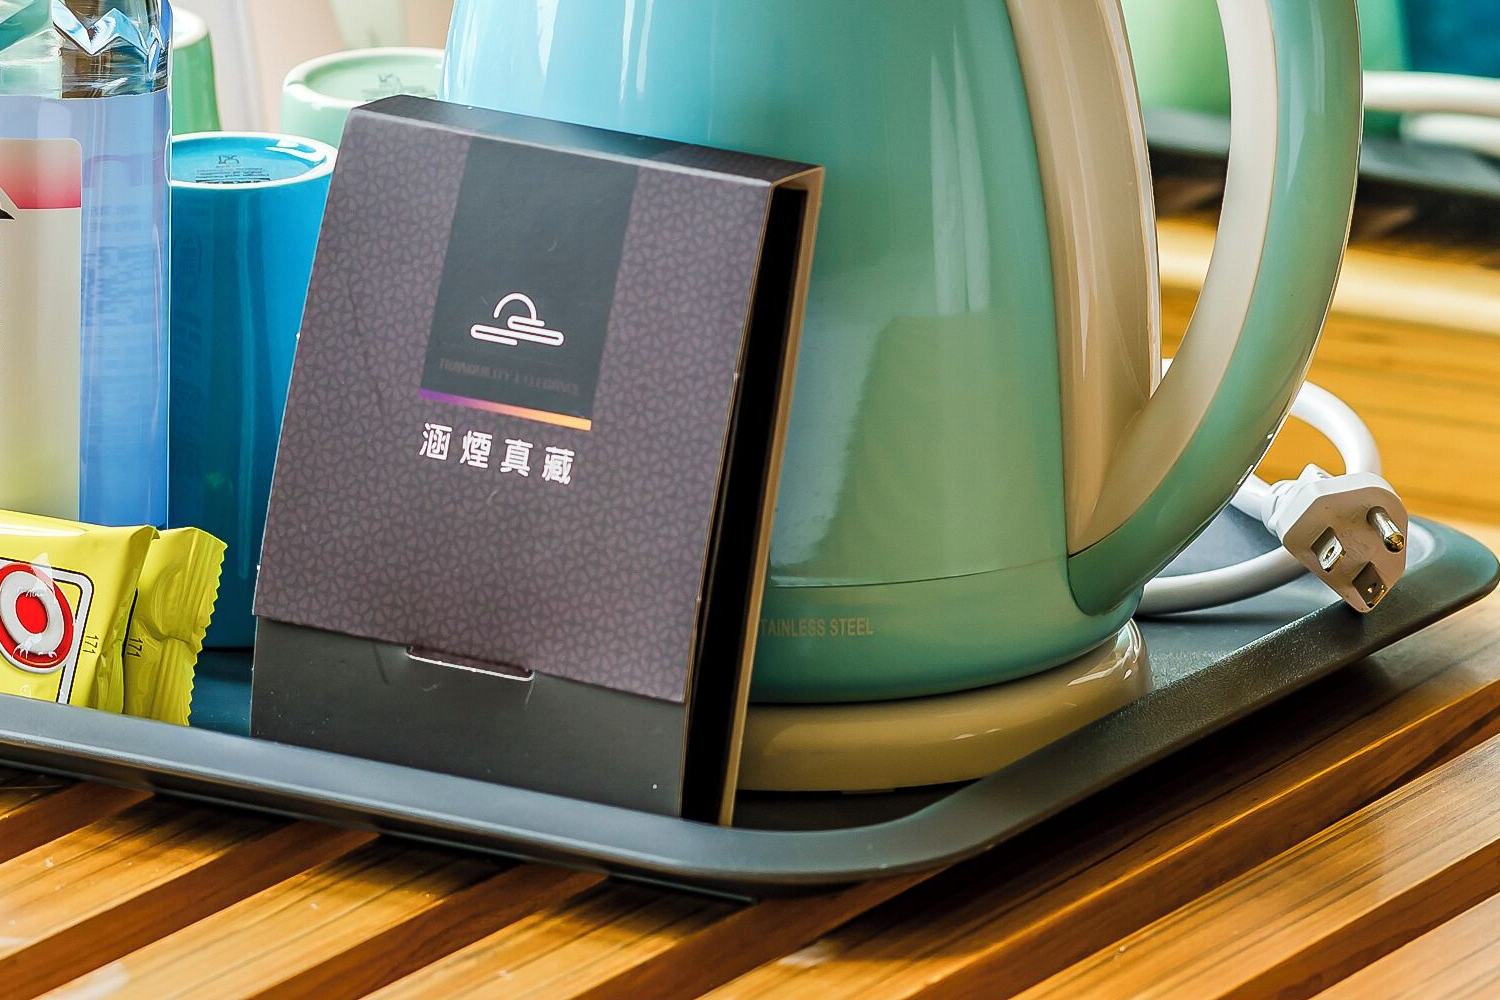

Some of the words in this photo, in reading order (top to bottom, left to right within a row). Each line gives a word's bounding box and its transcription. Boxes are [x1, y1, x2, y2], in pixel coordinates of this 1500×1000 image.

[419, 422, 575, 485] 涵煙真藏
[760, 618, 826, 638] TAINLESS
[829, 615, 874, 637] STEEL
[82, 635, 99, 654] 171
[126, 637, 143, 658] 171
